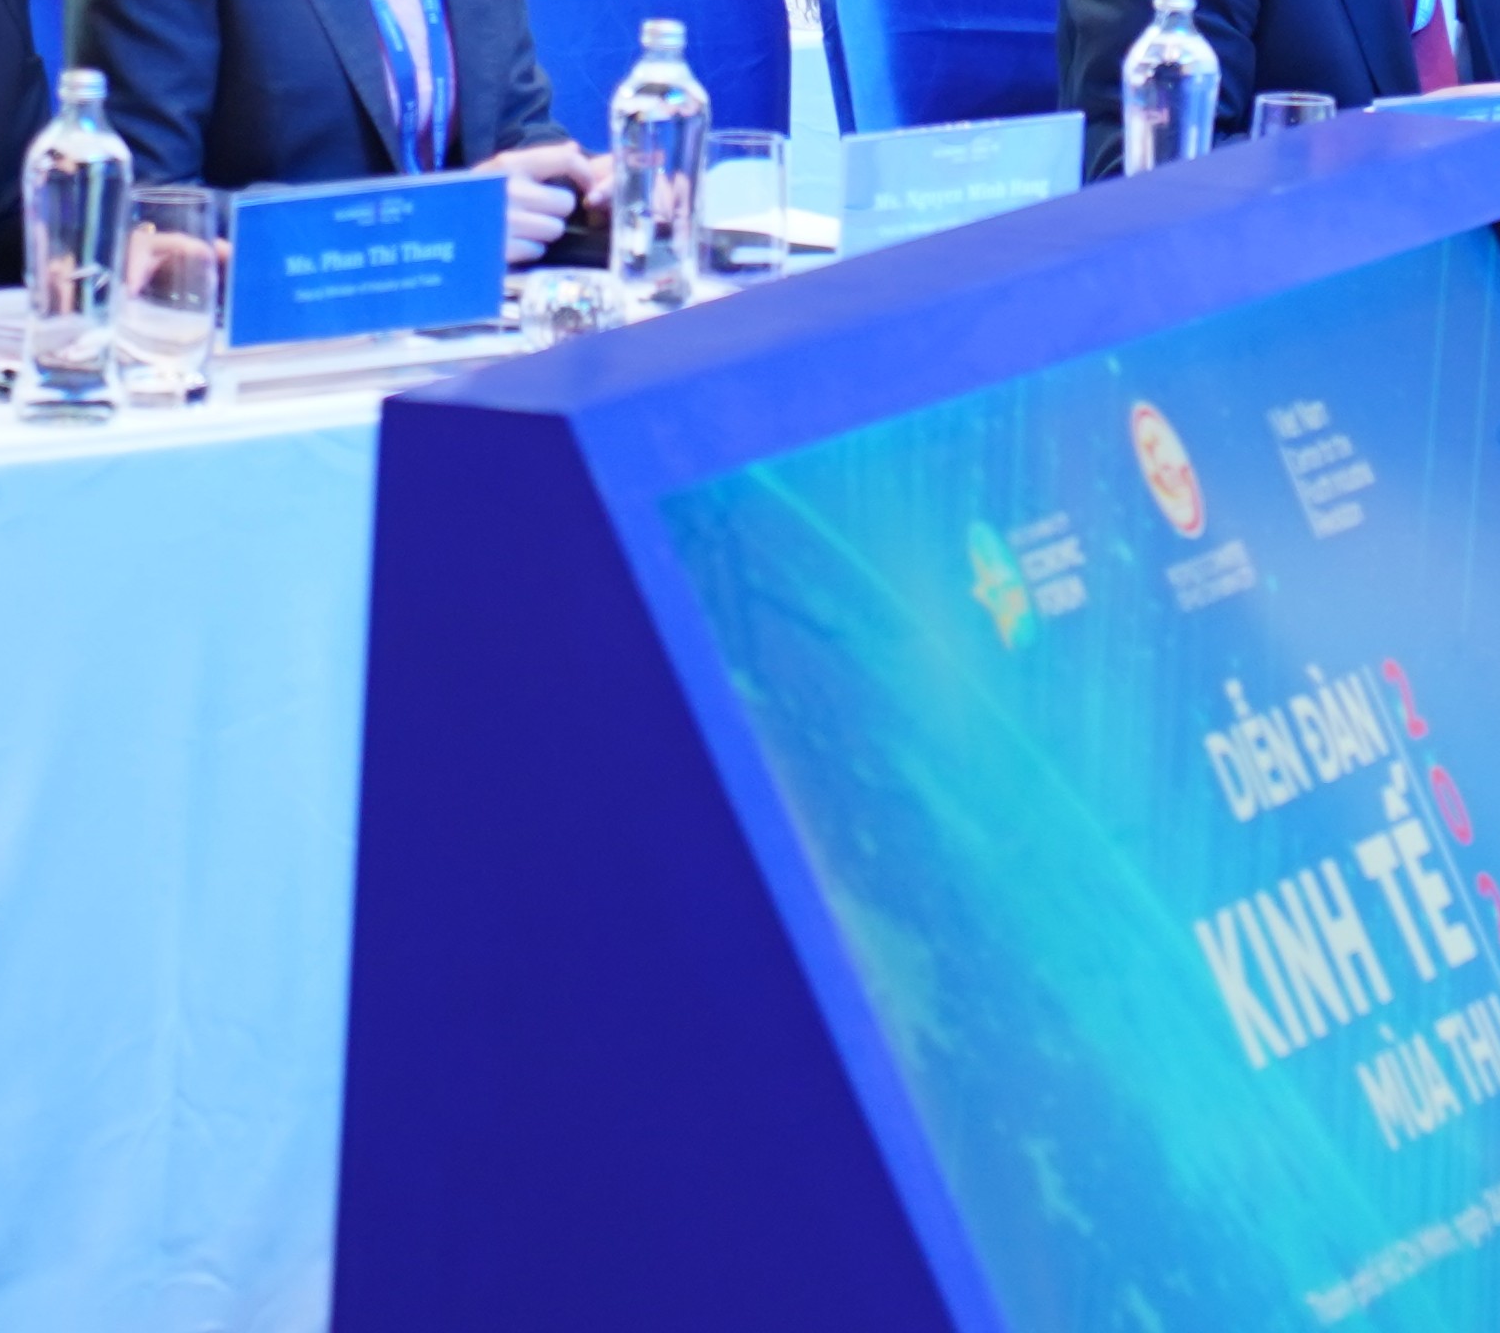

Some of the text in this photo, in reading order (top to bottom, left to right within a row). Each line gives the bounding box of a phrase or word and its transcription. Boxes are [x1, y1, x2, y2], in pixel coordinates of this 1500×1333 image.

[1290, 663, 1390, 783] ĐÀN
[1194, 760, 1477, 1070] KINH TẾ
[1357, 1021, 1463, 1151] MÙA
